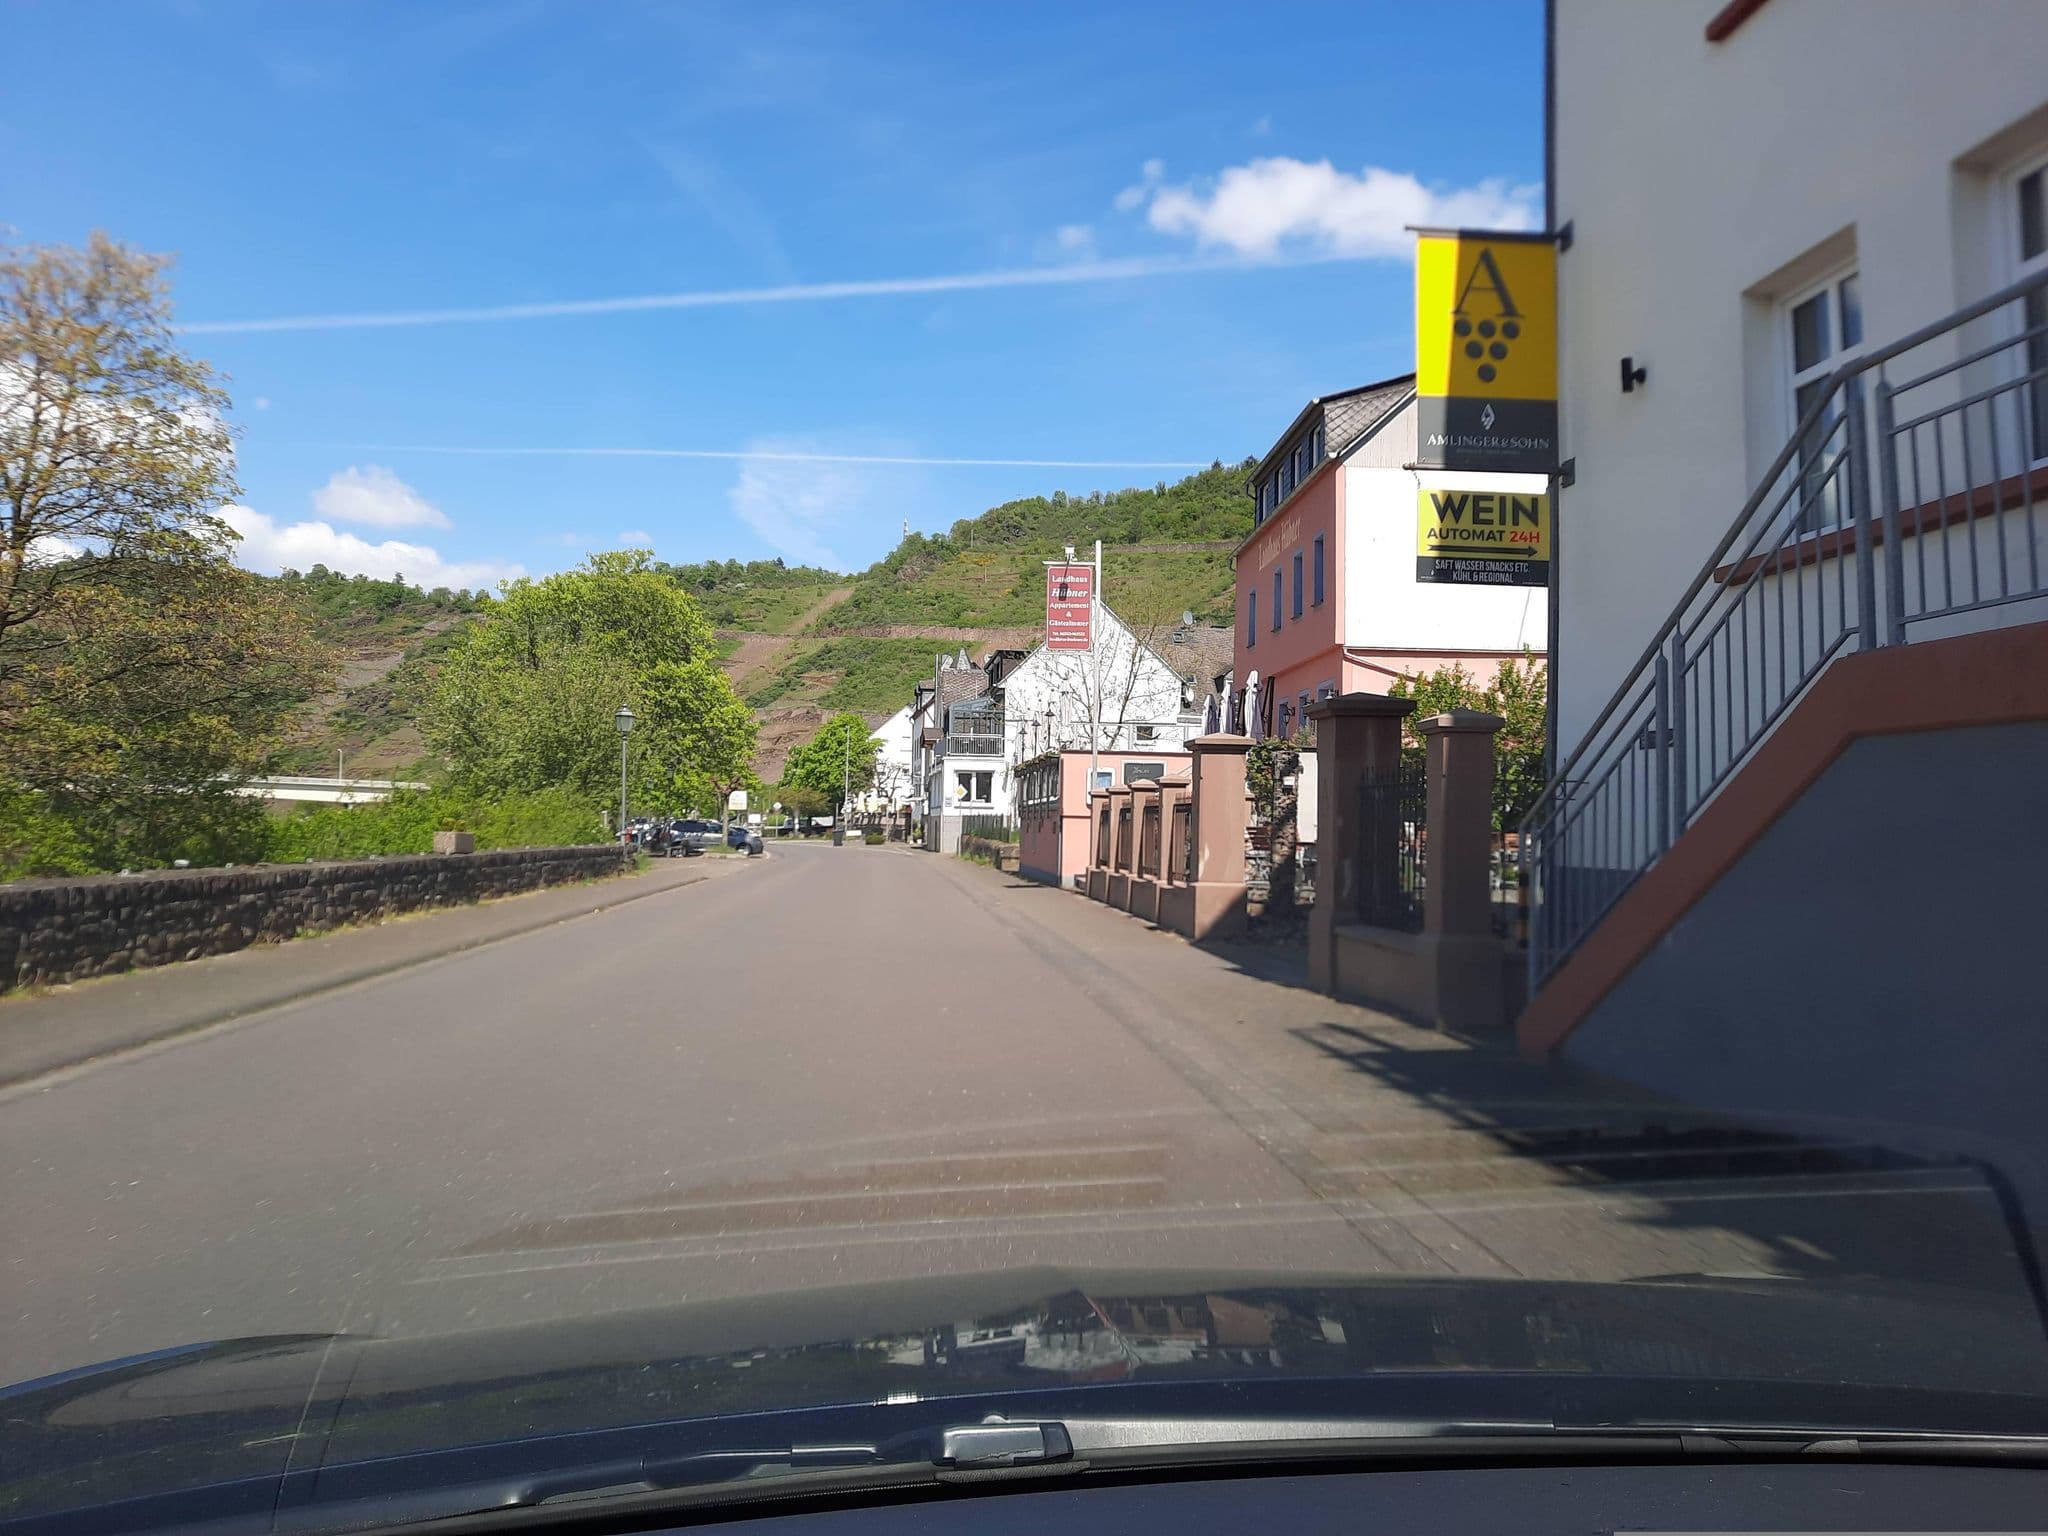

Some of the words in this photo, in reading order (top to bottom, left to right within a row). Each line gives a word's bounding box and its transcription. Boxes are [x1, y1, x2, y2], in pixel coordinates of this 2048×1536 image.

[1430, 493, 1539, 527] WEIN
[1427, 528, 1506, 542] AUTOMAT
[1509, 530, 1541, 544] 24H
[1435, 559, 1454, 570] SAFT
[1455, 560, 1485, 571] WASSER
[1485, 561, 1514, 572] SNACKS
[1052, 575, 1088, 583] Landhaus
[1473, 571, 1479, 582] &
[1480, 571, 1514, 583] REGIONAL
[1050, 602, 1089, 610] Appartement
